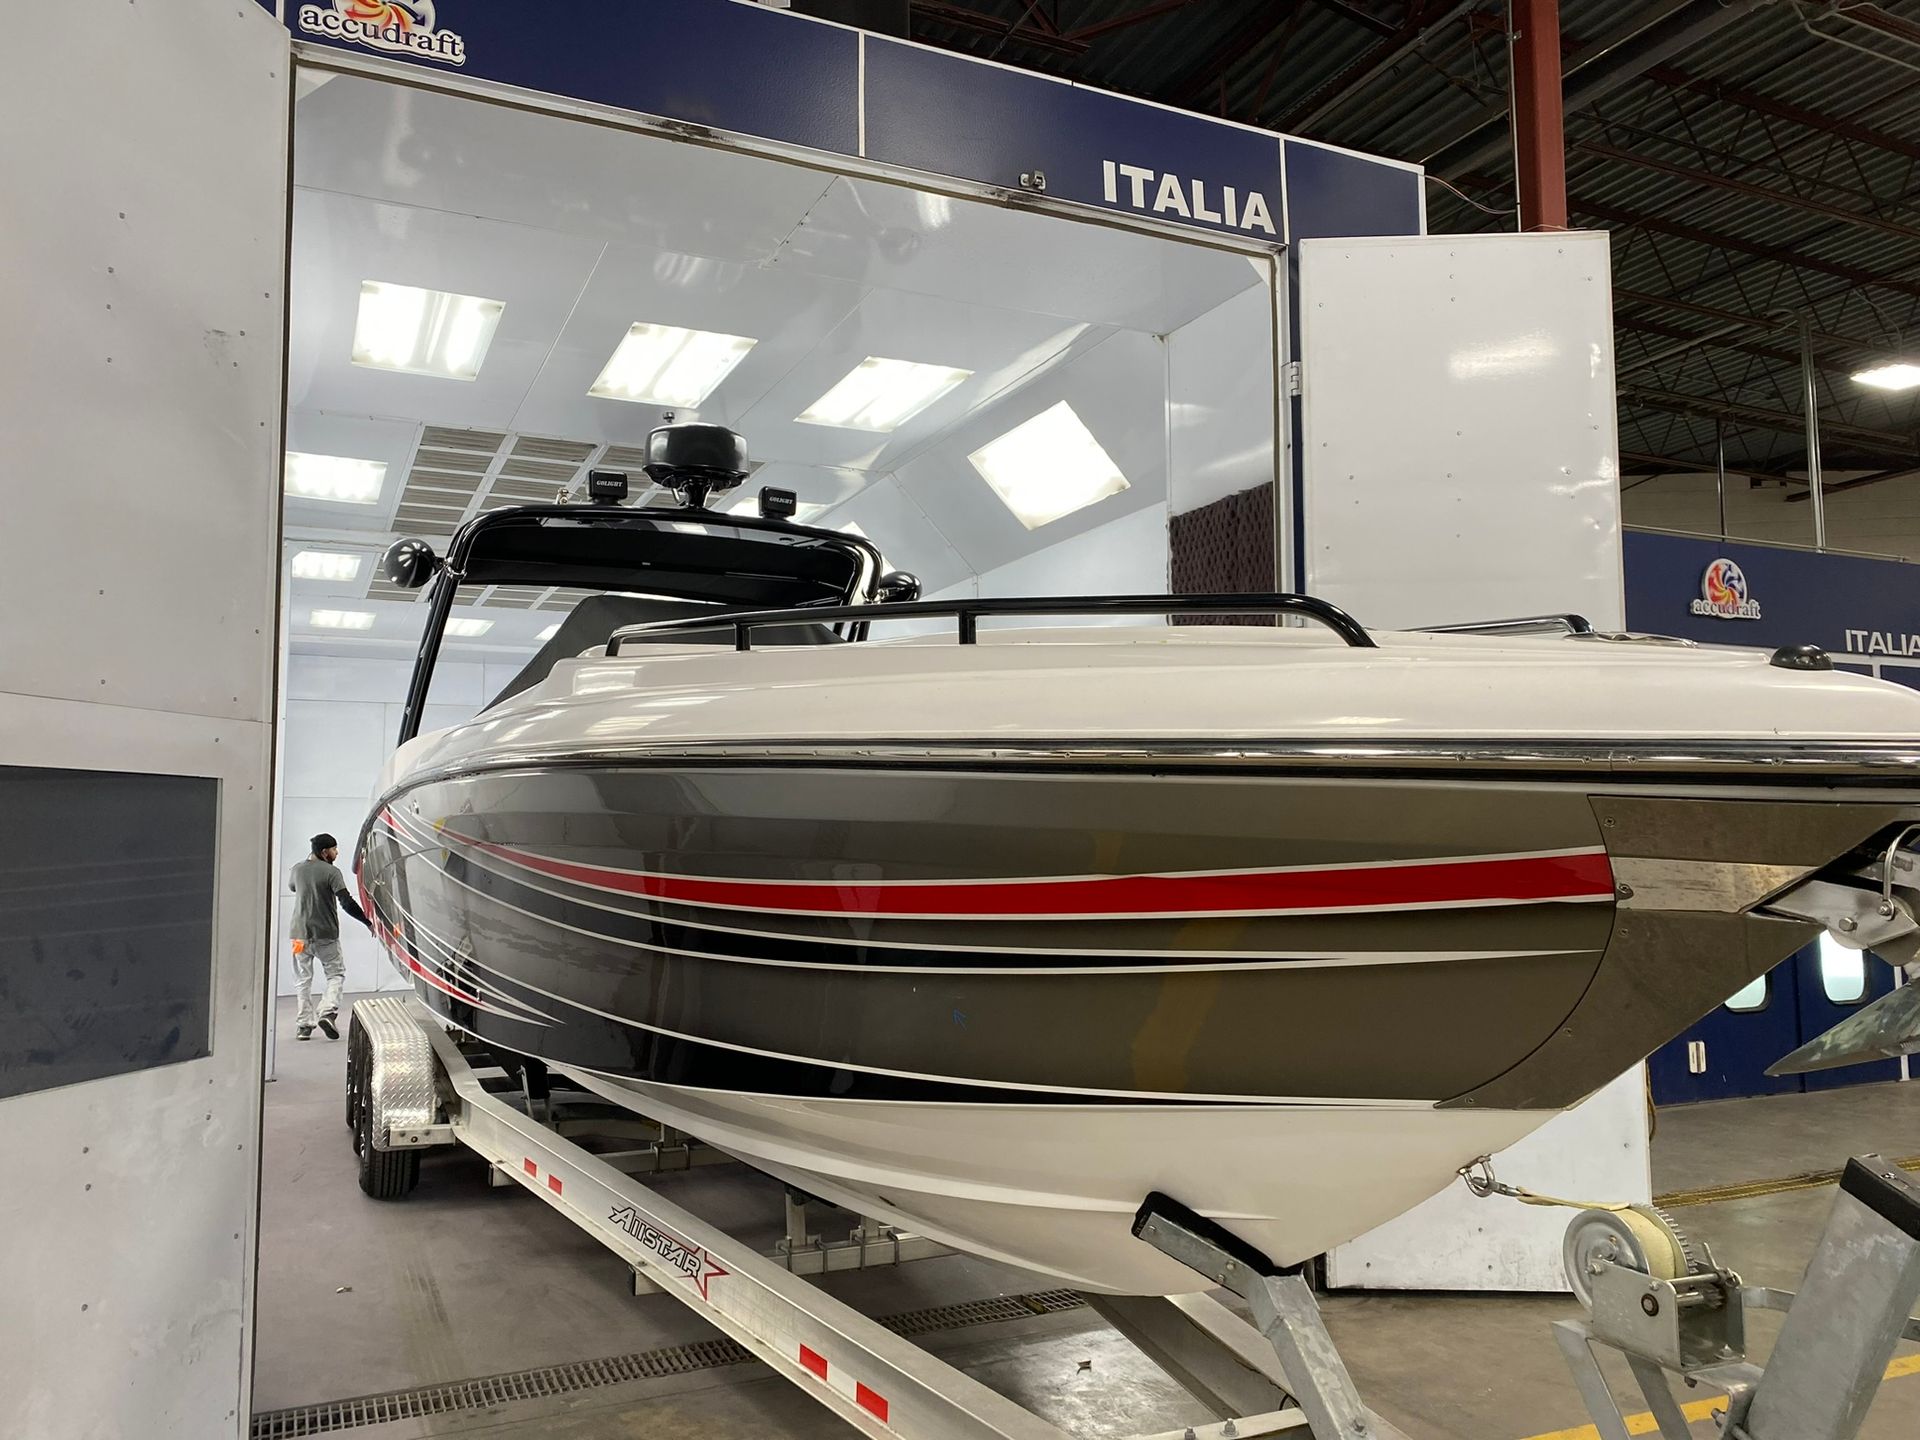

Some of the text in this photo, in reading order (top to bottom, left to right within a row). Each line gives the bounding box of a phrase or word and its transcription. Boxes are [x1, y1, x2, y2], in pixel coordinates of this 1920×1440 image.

[302, 8, 463, 56] accudraft
[1103, 159, 1277, 236] ITALIA
[1694, 600, 1760, 617] accudraft
[1845, 629, 1920, 656] ITALIA
